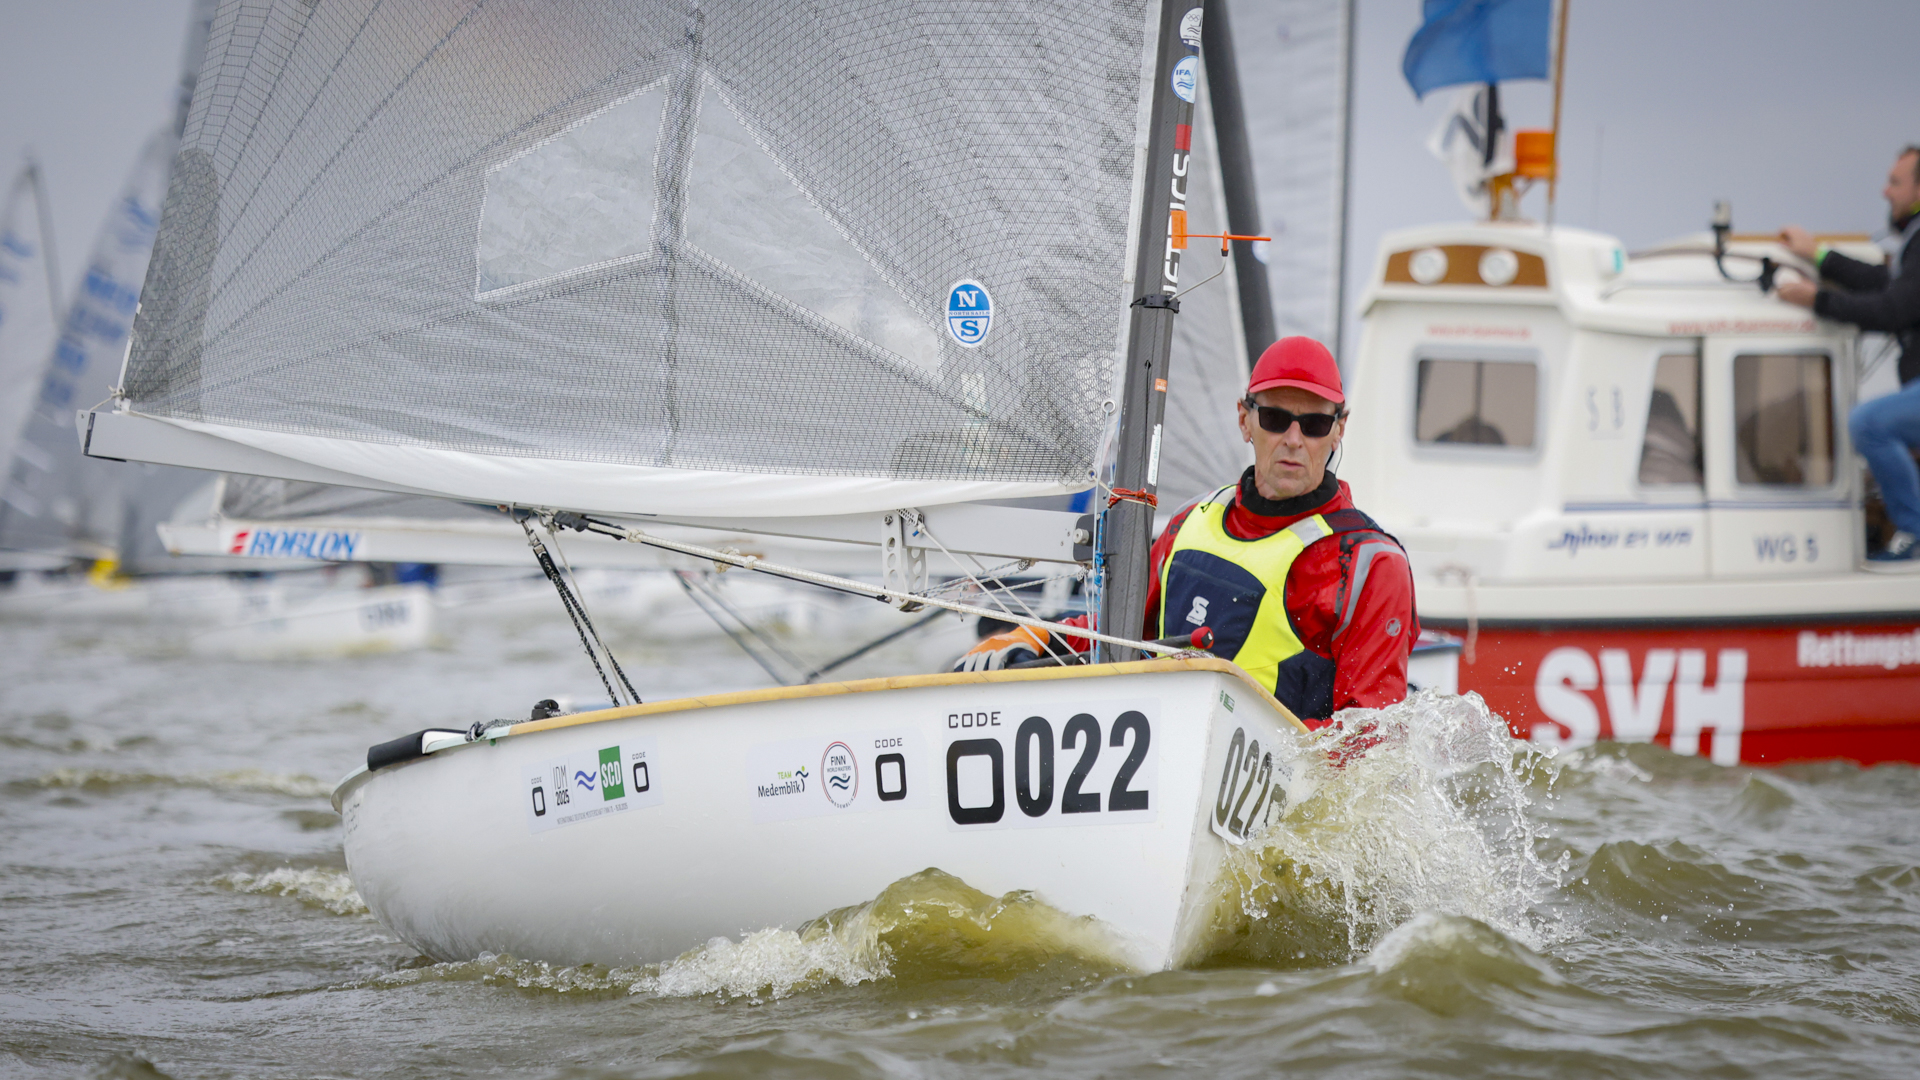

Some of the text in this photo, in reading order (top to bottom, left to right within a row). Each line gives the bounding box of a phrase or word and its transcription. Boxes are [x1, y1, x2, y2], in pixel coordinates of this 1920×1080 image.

[956, 290, 979, 308] N
[961, 320, 980, 337] S
[1755, 533, 1797, 562] WG
[1531, 646, 1747, 767] SVH
[948, 711, 1002, 729] CODE
[875, 737, 903, 749] CODE
[632, 751, 646, 760] CODE
[830, 755, 847, 766] FINN
[1014, 710, 1151, 818] 022
[531, 776, 542, 785] CODE
[553, 765, 568, 790] IDM
[601, 760, 622, 788] SCD
[777, 771, 792, 780] TEAM
[555, 789, 570, 806] 2025
[758, 781, 802, 798] Medemblik
